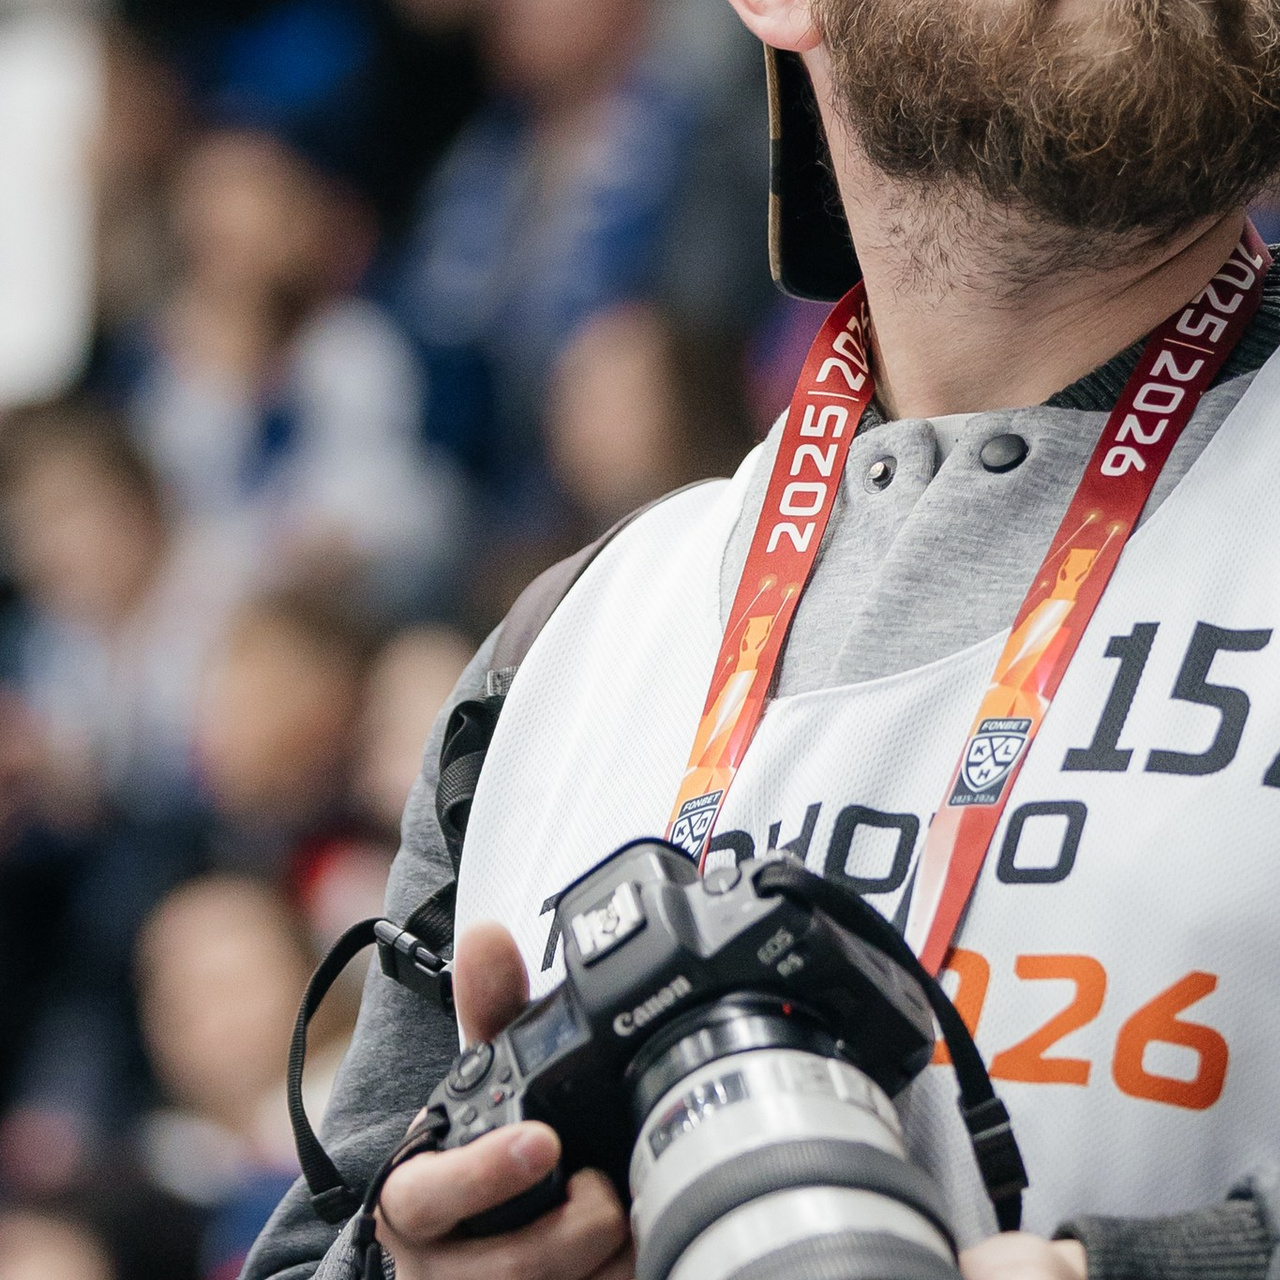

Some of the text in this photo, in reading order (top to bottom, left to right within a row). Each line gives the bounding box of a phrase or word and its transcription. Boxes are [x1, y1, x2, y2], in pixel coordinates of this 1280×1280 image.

[982, 721, 1027, 731] FONBET
[682, 793, 720, 812] FONBET
[613, 975, 693, 1037] Canon
